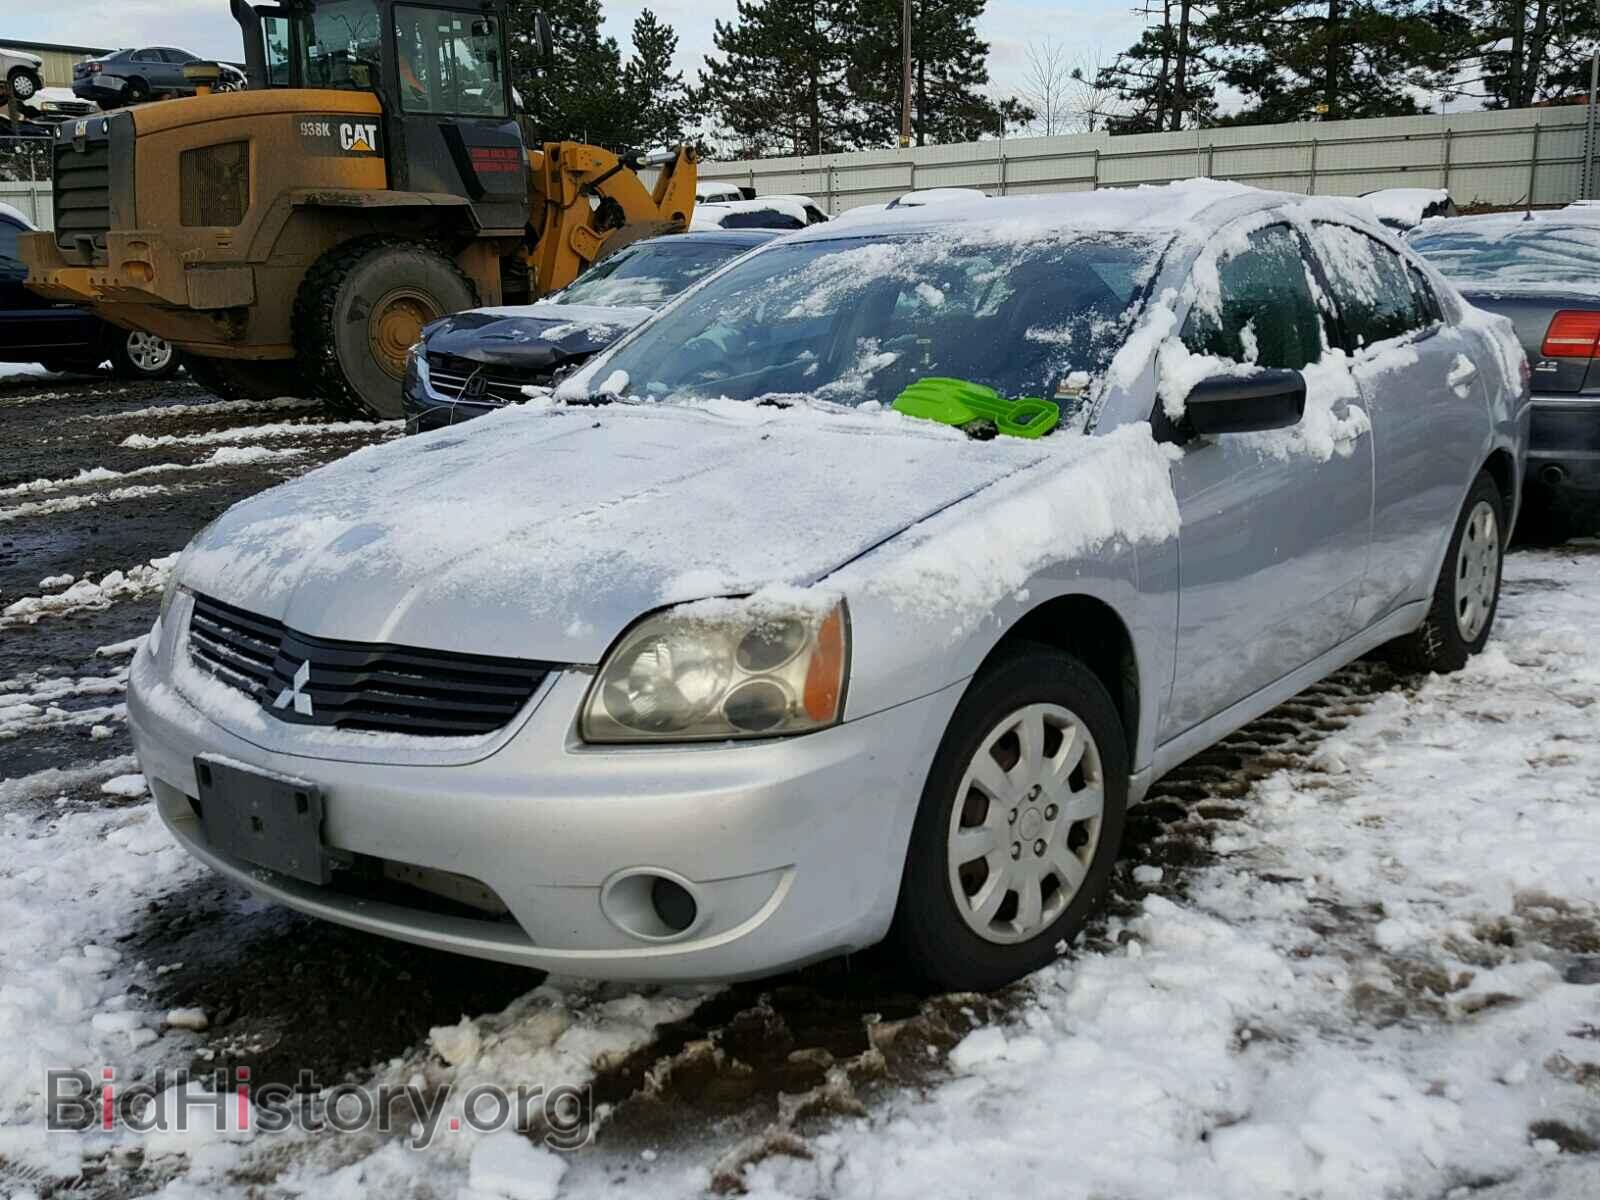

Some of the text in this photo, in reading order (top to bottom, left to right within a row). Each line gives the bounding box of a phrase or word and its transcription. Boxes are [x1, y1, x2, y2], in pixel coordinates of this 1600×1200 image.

[75, 120, 89, 136] CAT
[300, 122, 331, 137] 938K
[339, 122, 378, 152] CAT
